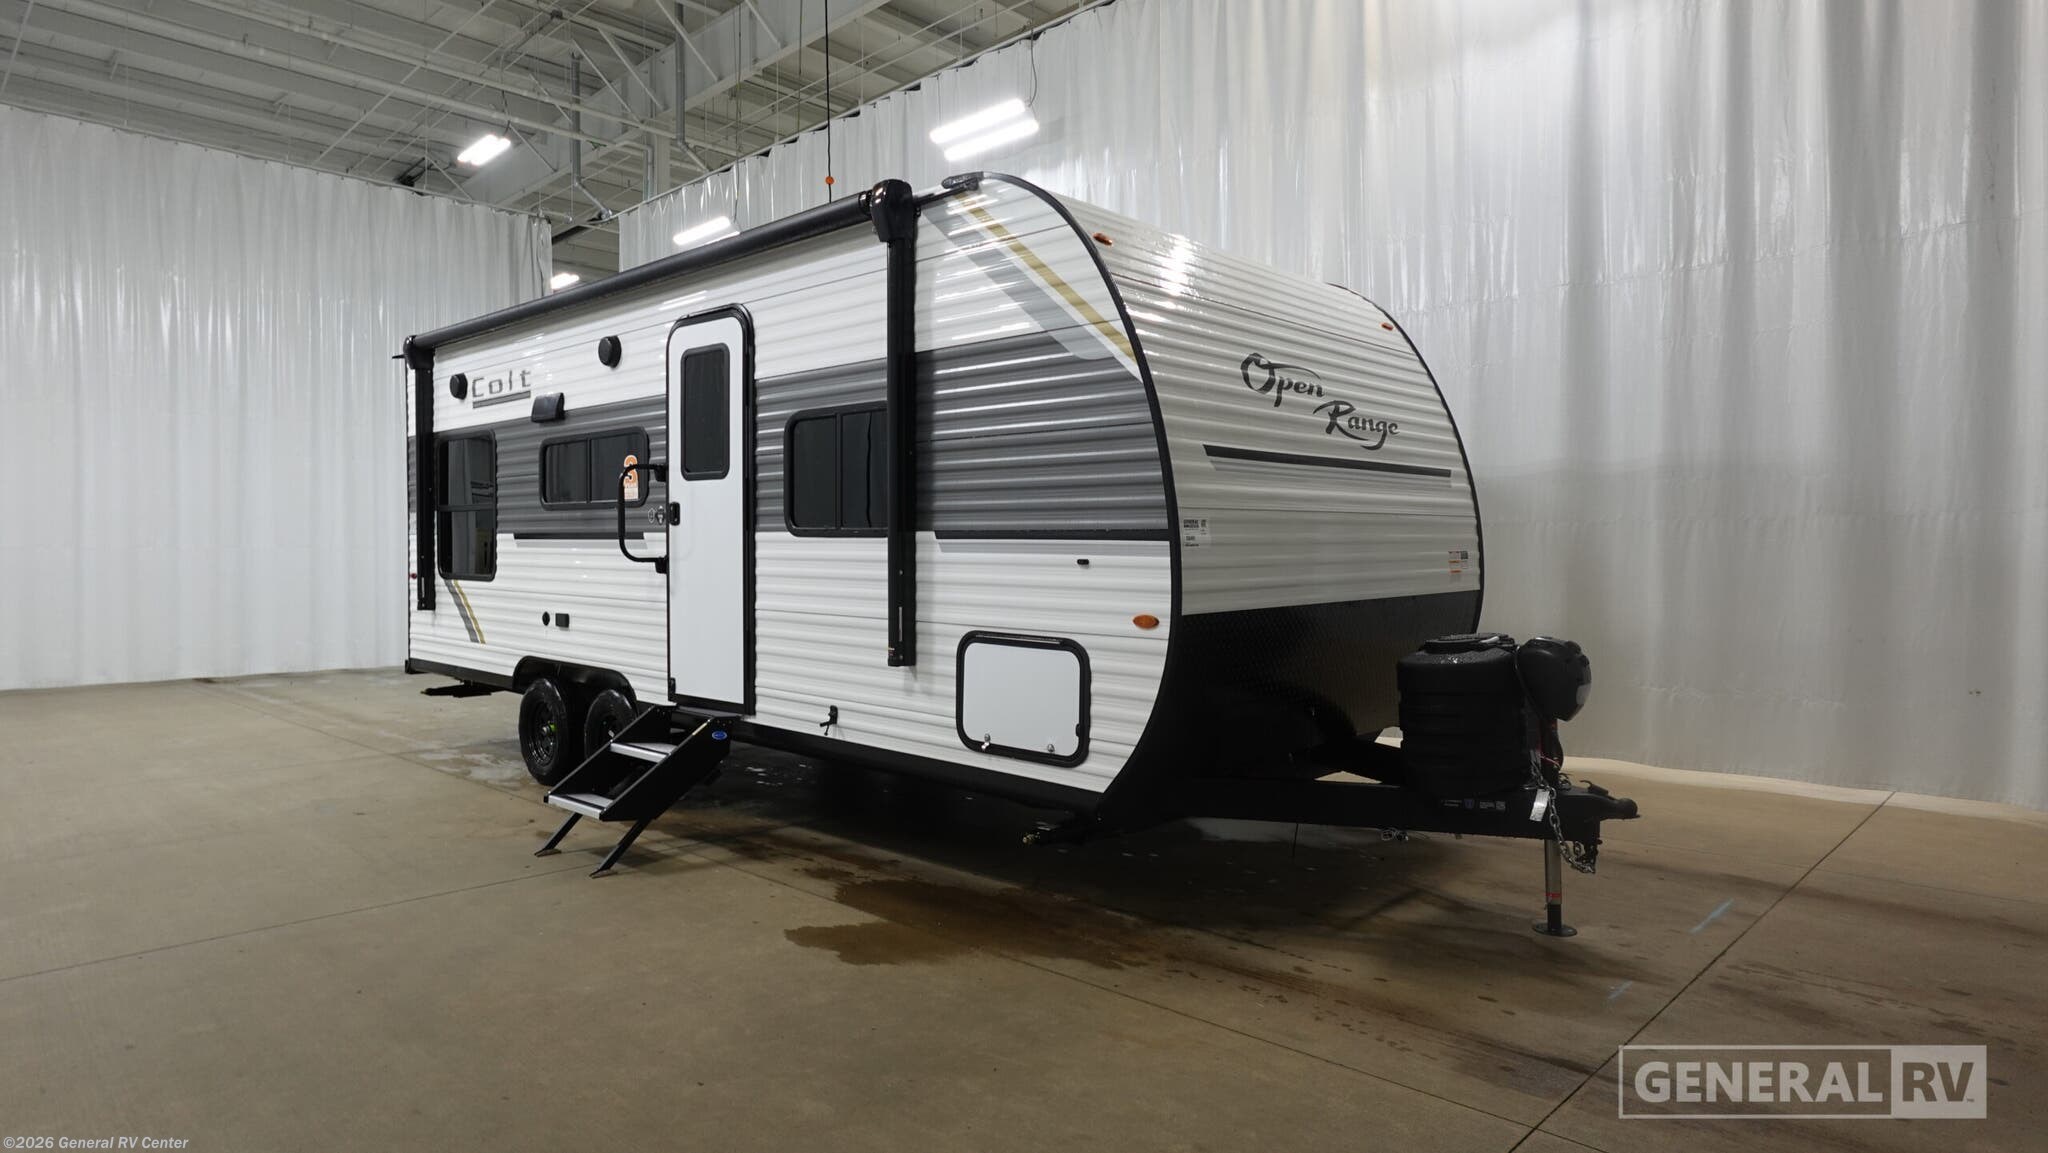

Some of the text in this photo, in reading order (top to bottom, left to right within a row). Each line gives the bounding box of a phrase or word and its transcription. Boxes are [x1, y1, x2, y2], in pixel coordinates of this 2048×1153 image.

[472, 369, 531, 397] Colt
[1240, 352, 1325, 407] Open
[1312, 400, 1399, 450] Range
